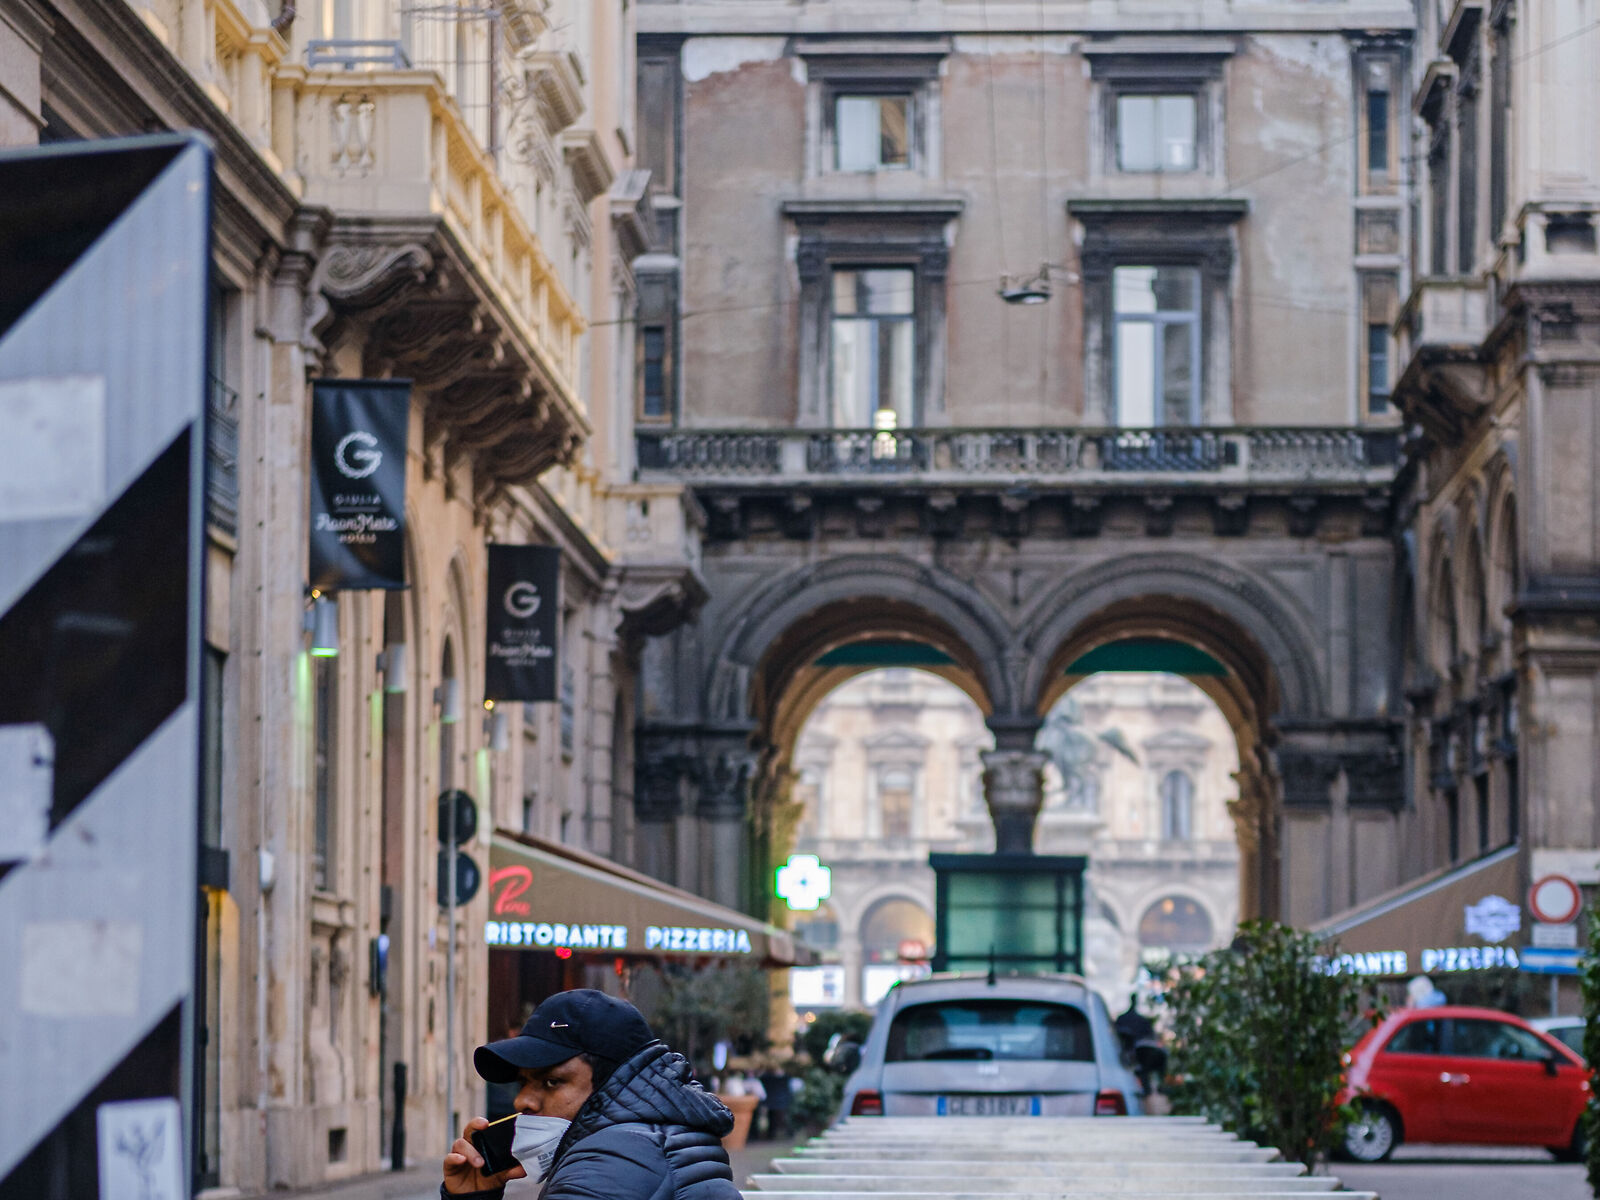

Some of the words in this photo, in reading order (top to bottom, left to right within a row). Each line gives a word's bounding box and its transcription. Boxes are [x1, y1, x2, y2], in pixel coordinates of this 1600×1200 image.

[334, 431, 383, 479] G
[504, 581, 541, 618] G
[485, 921, 628, 949] RISTORANTE
[645, 926, 752, 954] PIZZERIA
